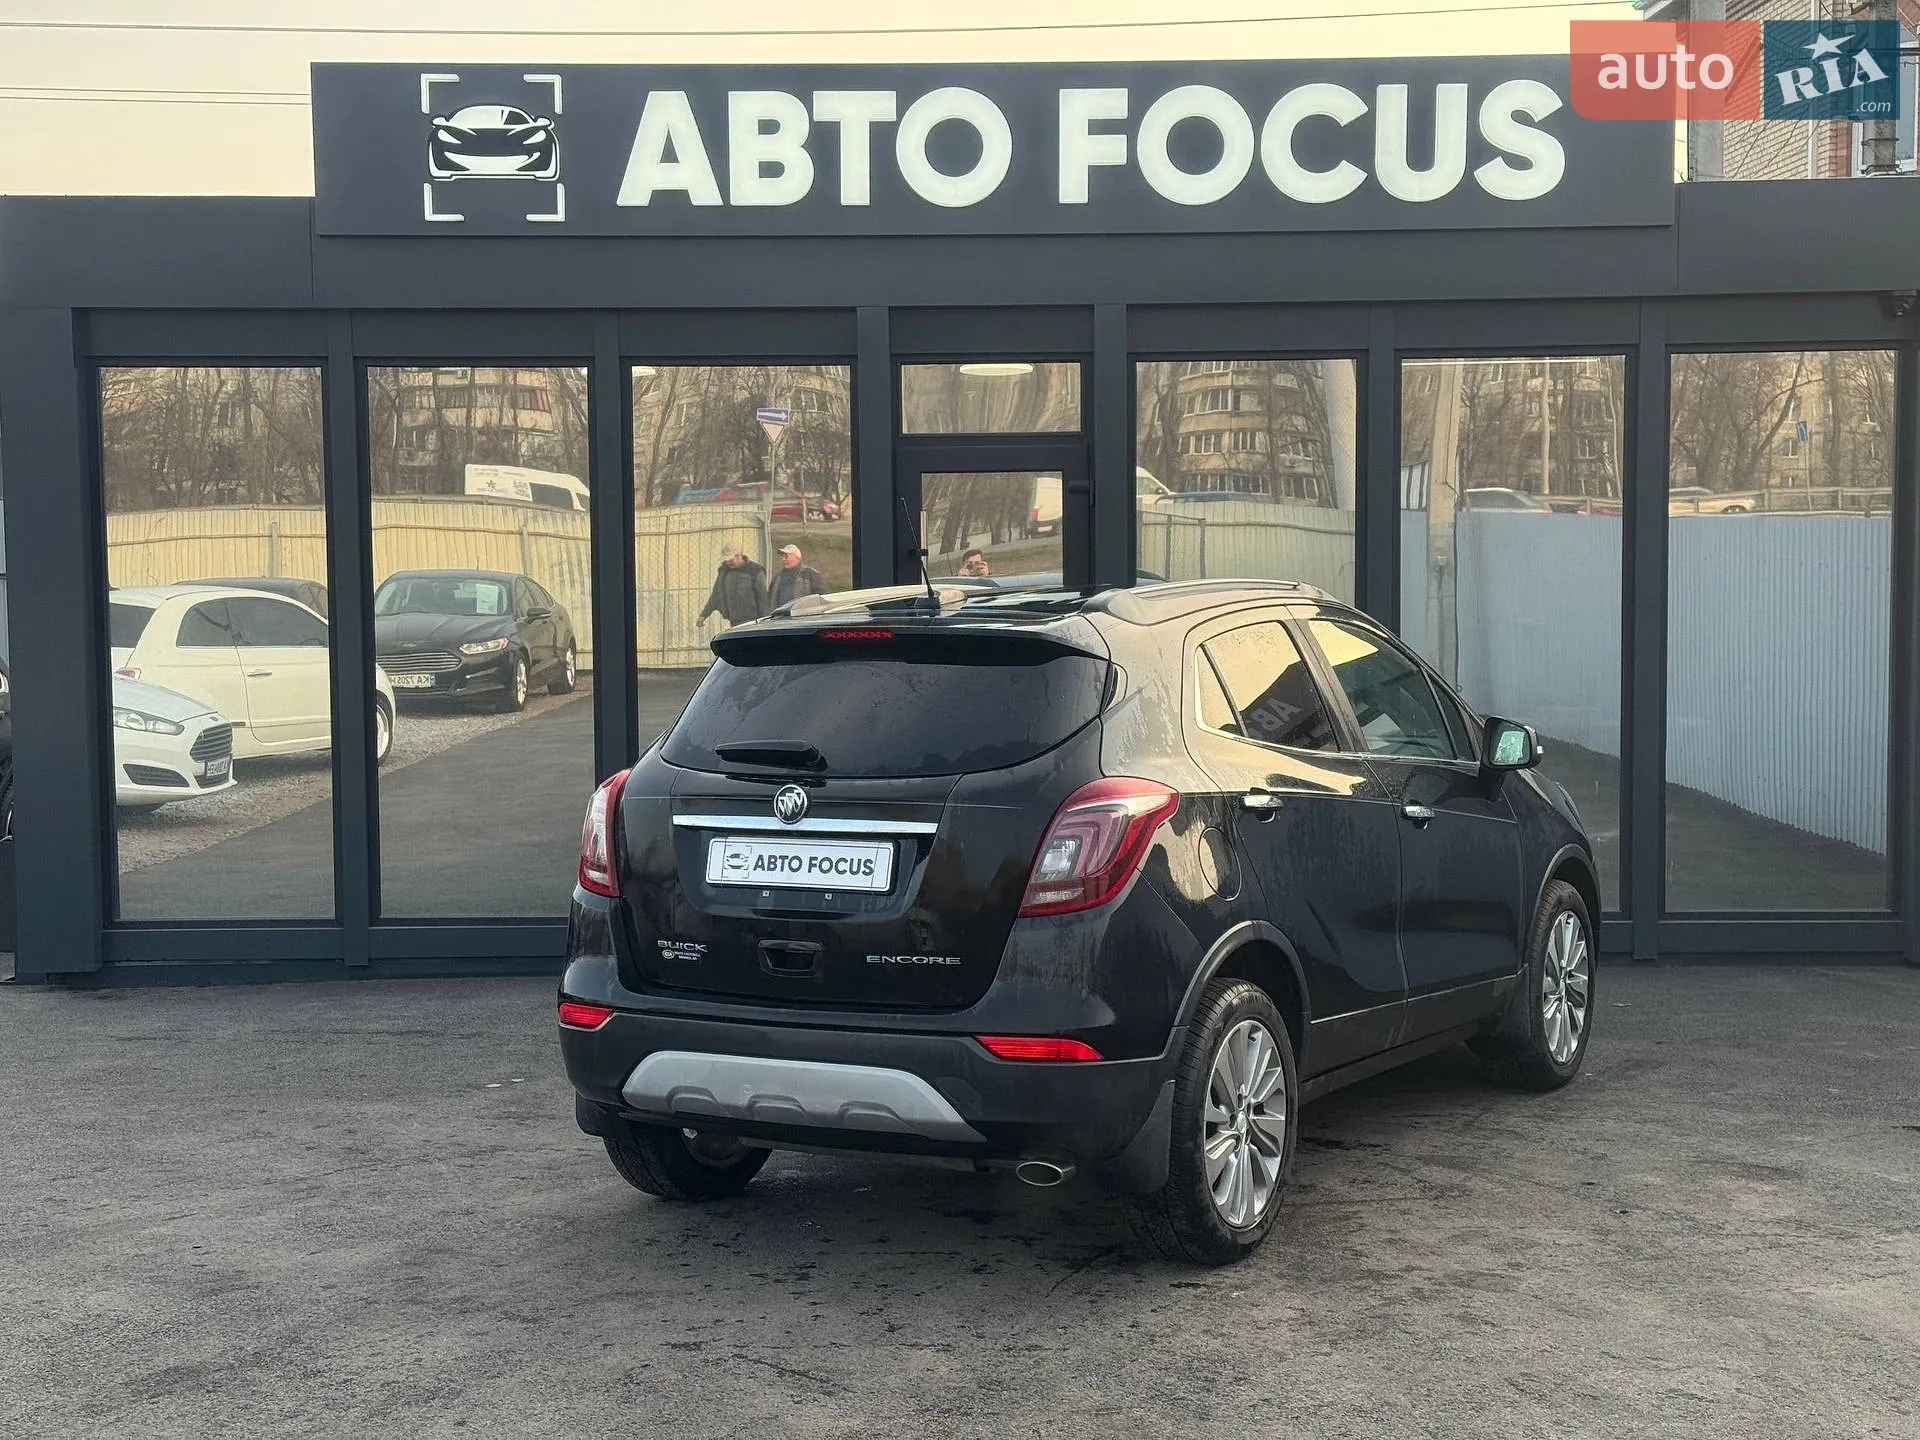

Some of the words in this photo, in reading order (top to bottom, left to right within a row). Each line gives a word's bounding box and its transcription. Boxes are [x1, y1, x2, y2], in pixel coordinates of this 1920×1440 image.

[616, 86, 1013, 208] АВТО
[1058, 79, 1566, 205] FOCUS
[752, 854, 803, 873] АВТО
[807, 856, 875, 877] FOCUS
[657, 939, 708, 953] BUICK
[866, 955, 961, 965] ENCORE
